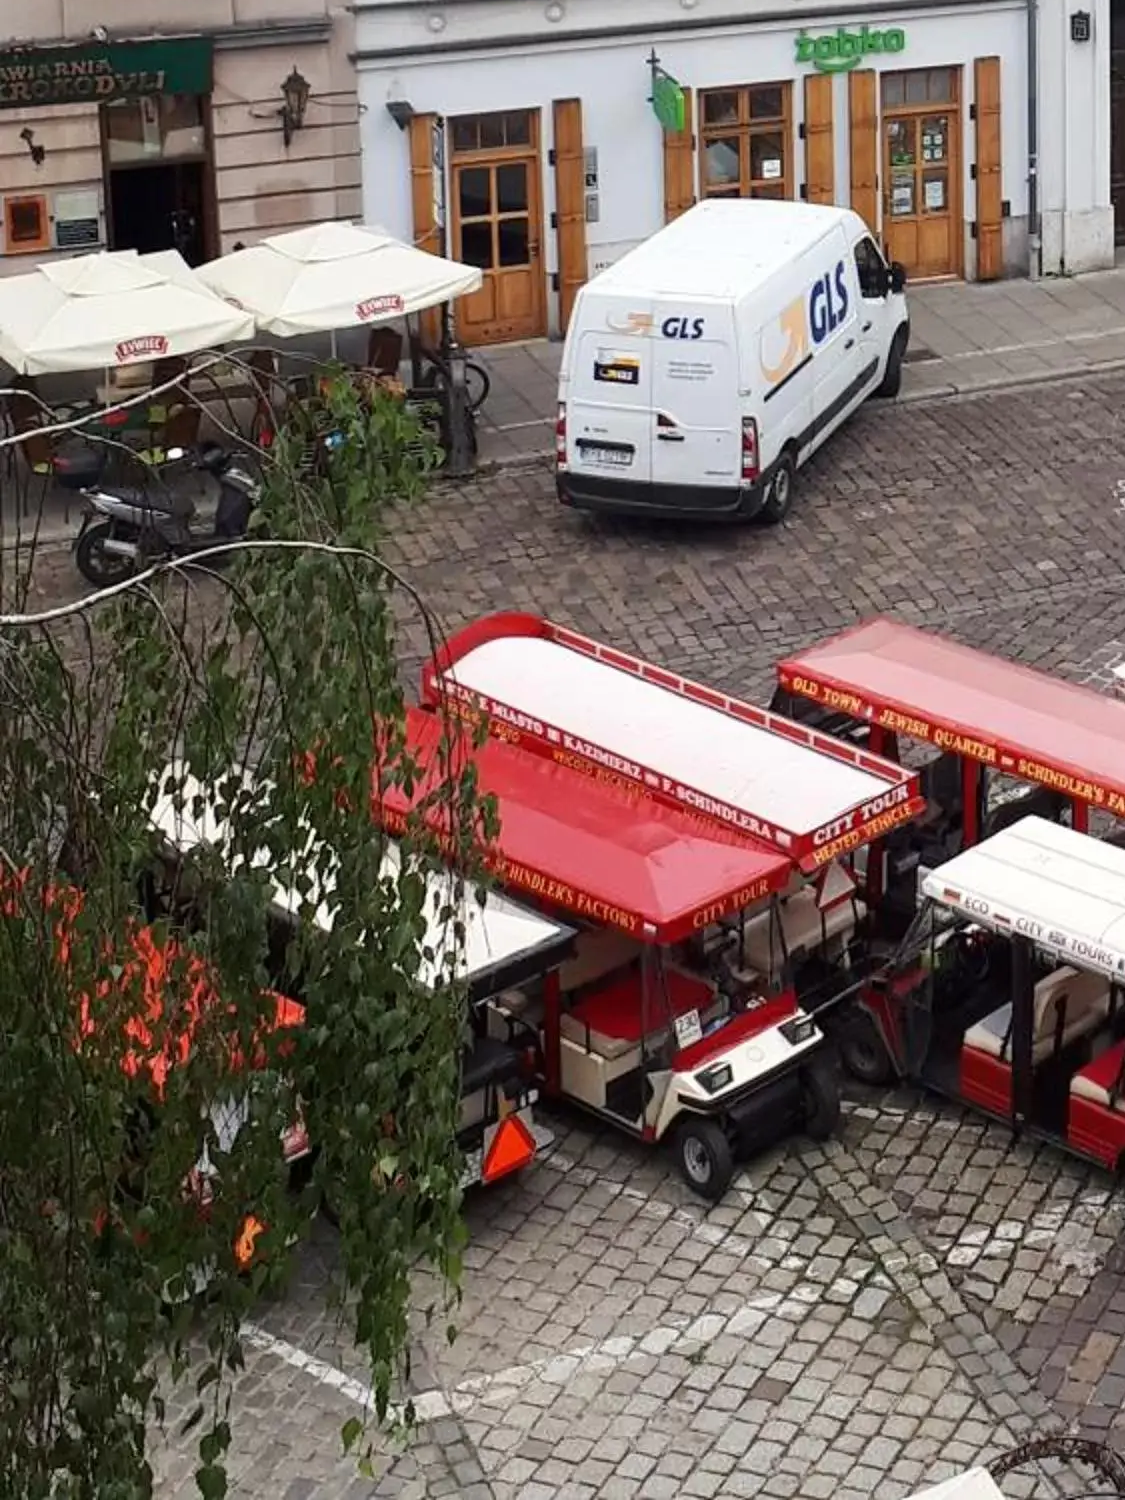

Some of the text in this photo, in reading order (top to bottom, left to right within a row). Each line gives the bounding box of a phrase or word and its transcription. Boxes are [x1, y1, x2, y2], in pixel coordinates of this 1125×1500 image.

[661, 317, 705, 339] GLS
[810, 260, 848, 344] GLS
[492, 702, 544, 734] MIASTO
[564, 735, 642, 779] KAZIMIERZ
[676, 782, 772, 839] SCHINDLERA
[793, 676, 819, 696] OLD
[823, 686, 862, 712] TOWN
[879, 709, 929, 737] JEWISH
[934, 728, 996, 762] QUARTER
[1018, 759, 1104, 804] SCHINDLER'S
[813, 785, 909, 846] CITY TOUR
[814, 803, 912, 865] HEATED VEHICLE
[577, 893, 638, 931] FACTORY
[693, 879, 769, 928] CITY TOUR
[965, 896, 989, 915] ECO
[1015, 917, 1044, 937] CITY
[1071, 937, 1114, 966] TOURS
